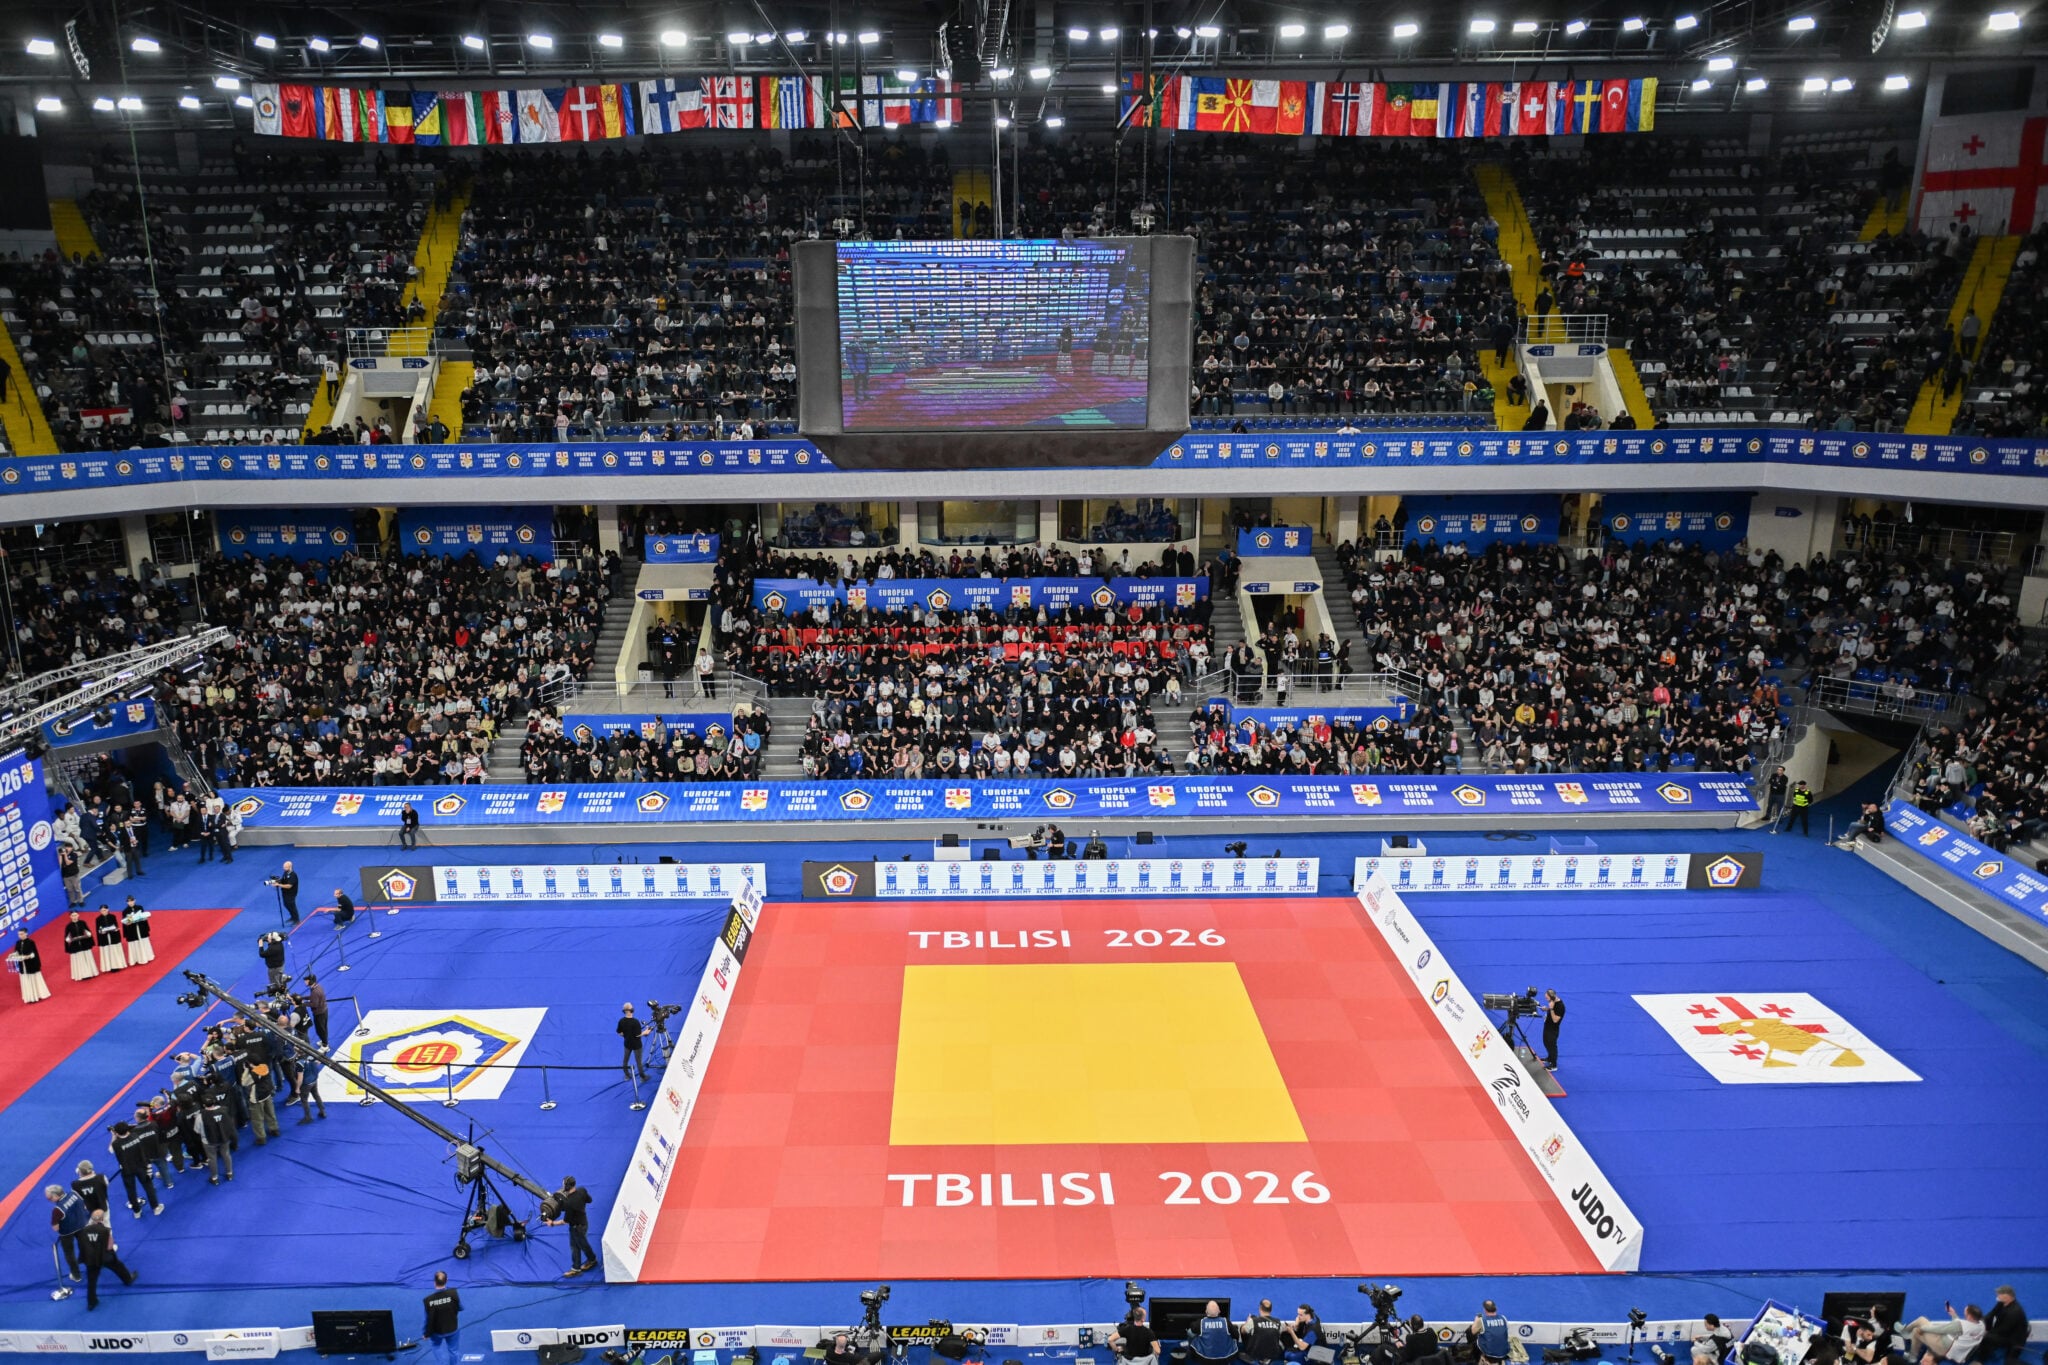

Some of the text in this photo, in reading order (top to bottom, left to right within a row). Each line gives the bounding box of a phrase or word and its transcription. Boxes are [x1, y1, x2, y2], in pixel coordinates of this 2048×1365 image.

[800, 589, 835, 597] EUROPEAN
[879, 589, 914, 597] EUROPEAN
[964, 587, 1000, 595] EUROPEAN
[1043, 586, 1079, 594] EUROPEAN
[1129, 585, 1165, 593] EUROPEAN
[809, 597, 827, 605] JUDO
[888, 596, 906, 604] JUDO
[973, 595, 991, 603] JUDO
[1052, 594, 1070, 602] JUDO
[1138, 593, 1156, 601] JUDO
[1292, 785, 1340, 793] EUROPEAN
[1389, 784, 1438, 792] EUROPEAN
[1592, 782, 1643, 790] EUROPEAN
[578, 791, 626, 799] EUROPEAN
[683, 790, 732, 798] EUROPEAN
[780, 789, 828, 797] EUROPEAN
[983, 788, 1031, 796] EUROPEAN
[1306, 792, 1330, 800] JUDO
[1404, 791, 1429, 799] JUDO
[1609, 789, 1634, 797] JUDO
[279, 795, 328, 803] EUROPEAN
[588, 798, 612, 806] JUDO
[791, 796, 815, 804] JUDO
[898, 796, 922, 804] JUDO
[995, 795, 1019, 803] JUDO
[1304, 799, 1336, 807] UNION
[1403, 798, 1434, 806] UNION
[1609, 796, 1641, 804] UNION
[490, 800, 515, 808] JUDO
[689, 804, 720, 812] UNION
[787, 803, 817, 811] UNION
[894, 803, 924, 811] UNION
[992, 802, 1022, 810] UNION
[281, 809, 312, 817] UNION
[485, 807, 516, 815] UNION
[582, 805, 613, 813] UNION
[1900, 809, 1927, 826] EUROPEAN
[1952, 838, 1982, 856] EUROPEAN
[2016, 873, 2048, 893] EUROPEAN
[726, 912, 742, 948] LEADER
[908, 928, 1226, 948] TBILISI 2026
[187, 1086, 197, 1094] TV
[1510, 1089, 1531, 1119] ZEBRA
[214, 1114, 222, 1122] TV
[82, 1187, 94, 1195] TV
[887, 1170, 1331, 1206] TBILISI 2026
[1571, 1182, 1626, 1245] JUDO TV
[88, 1234, 98, 1242] TV
[430, 1296, 451, 1307] PRESS
[1205, 1321, 1223, 1329] PHOTO
[628, 1330, 686, 1342] LEADER
[892, 1327, 950, 1337] LEADER
[568, 1330, 620, 1345] JUDO TV
[89, 1338, 132, 1350] JUDO
[645, 1340, 684, 1349] SPORT
